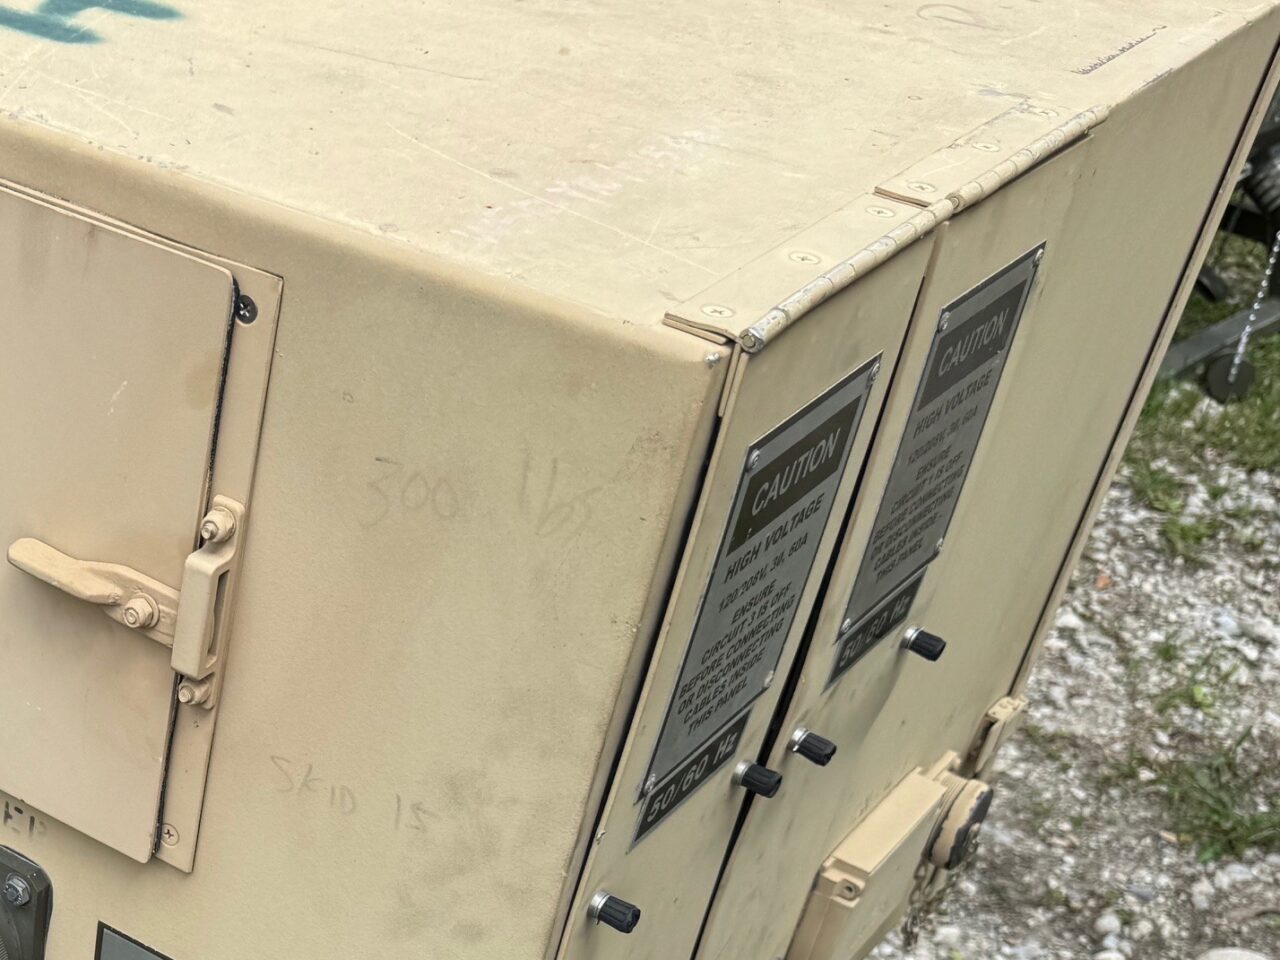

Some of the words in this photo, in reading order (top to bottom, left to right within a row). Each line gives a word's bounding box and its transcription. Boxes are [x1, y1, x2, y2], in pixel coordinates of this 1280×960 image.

[935, 305, 1009, 380] CAUTION
[912, 403, 943, 439] HIGH
[942, 367, 993, 418] VOLTAGE
[748, 426, 841, 520] CAUTION
[723, 541, 762, 585] HIGH
[761, 491, 825, 554] VOLTAGE
[699, 617, 747, 666] CIRCUIT
[746, 610, 756, 628] 3
[756, 599, 769, 620] IS
[769, 580, 792, 609] OFF
[730, 578, 776, 626] ENSURE
[676, 690, 695, 717] OR
[695, 616, 784, 700] DISCONNECTING
[677, 651, 725, 700] BEFORE
[724, 593, 796, 661] CONNECTING
[682, 678, 727, 726] CABLES
[727, 646, 765, 687] INSIDE
[686, 704, 713, 737] THIS
[713, 673, 749, 713] PANEL
[647, 755, 709, 822] 50/60
[713, 732, 738, 765] Hz
